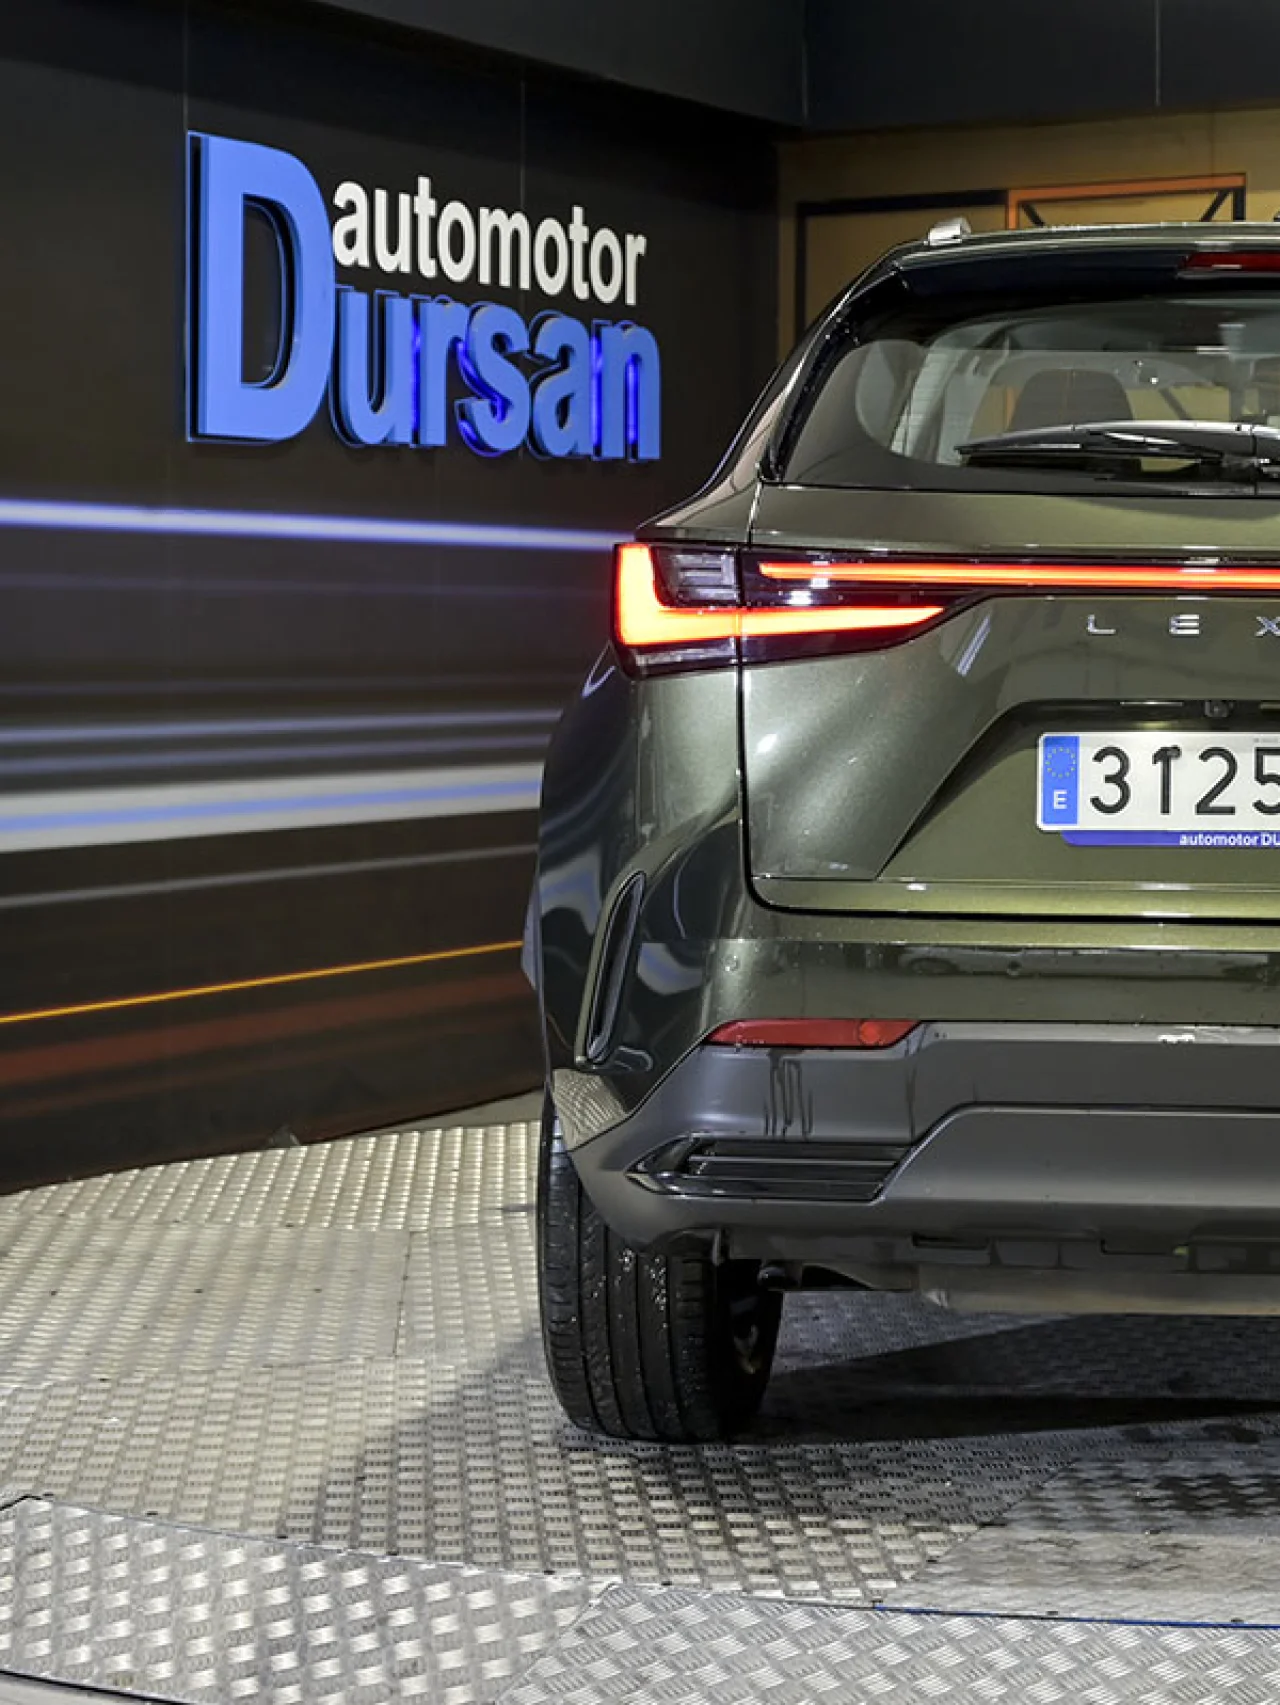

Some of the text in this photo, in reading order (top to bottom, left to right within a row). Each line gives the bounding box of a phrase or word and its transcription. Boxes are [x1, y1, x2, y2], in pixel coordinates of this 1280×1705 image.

[186, 130, 661, 462] Dursan
[333, 176, 647, 305] automotor
[1053, 790, 1067, 809] E
